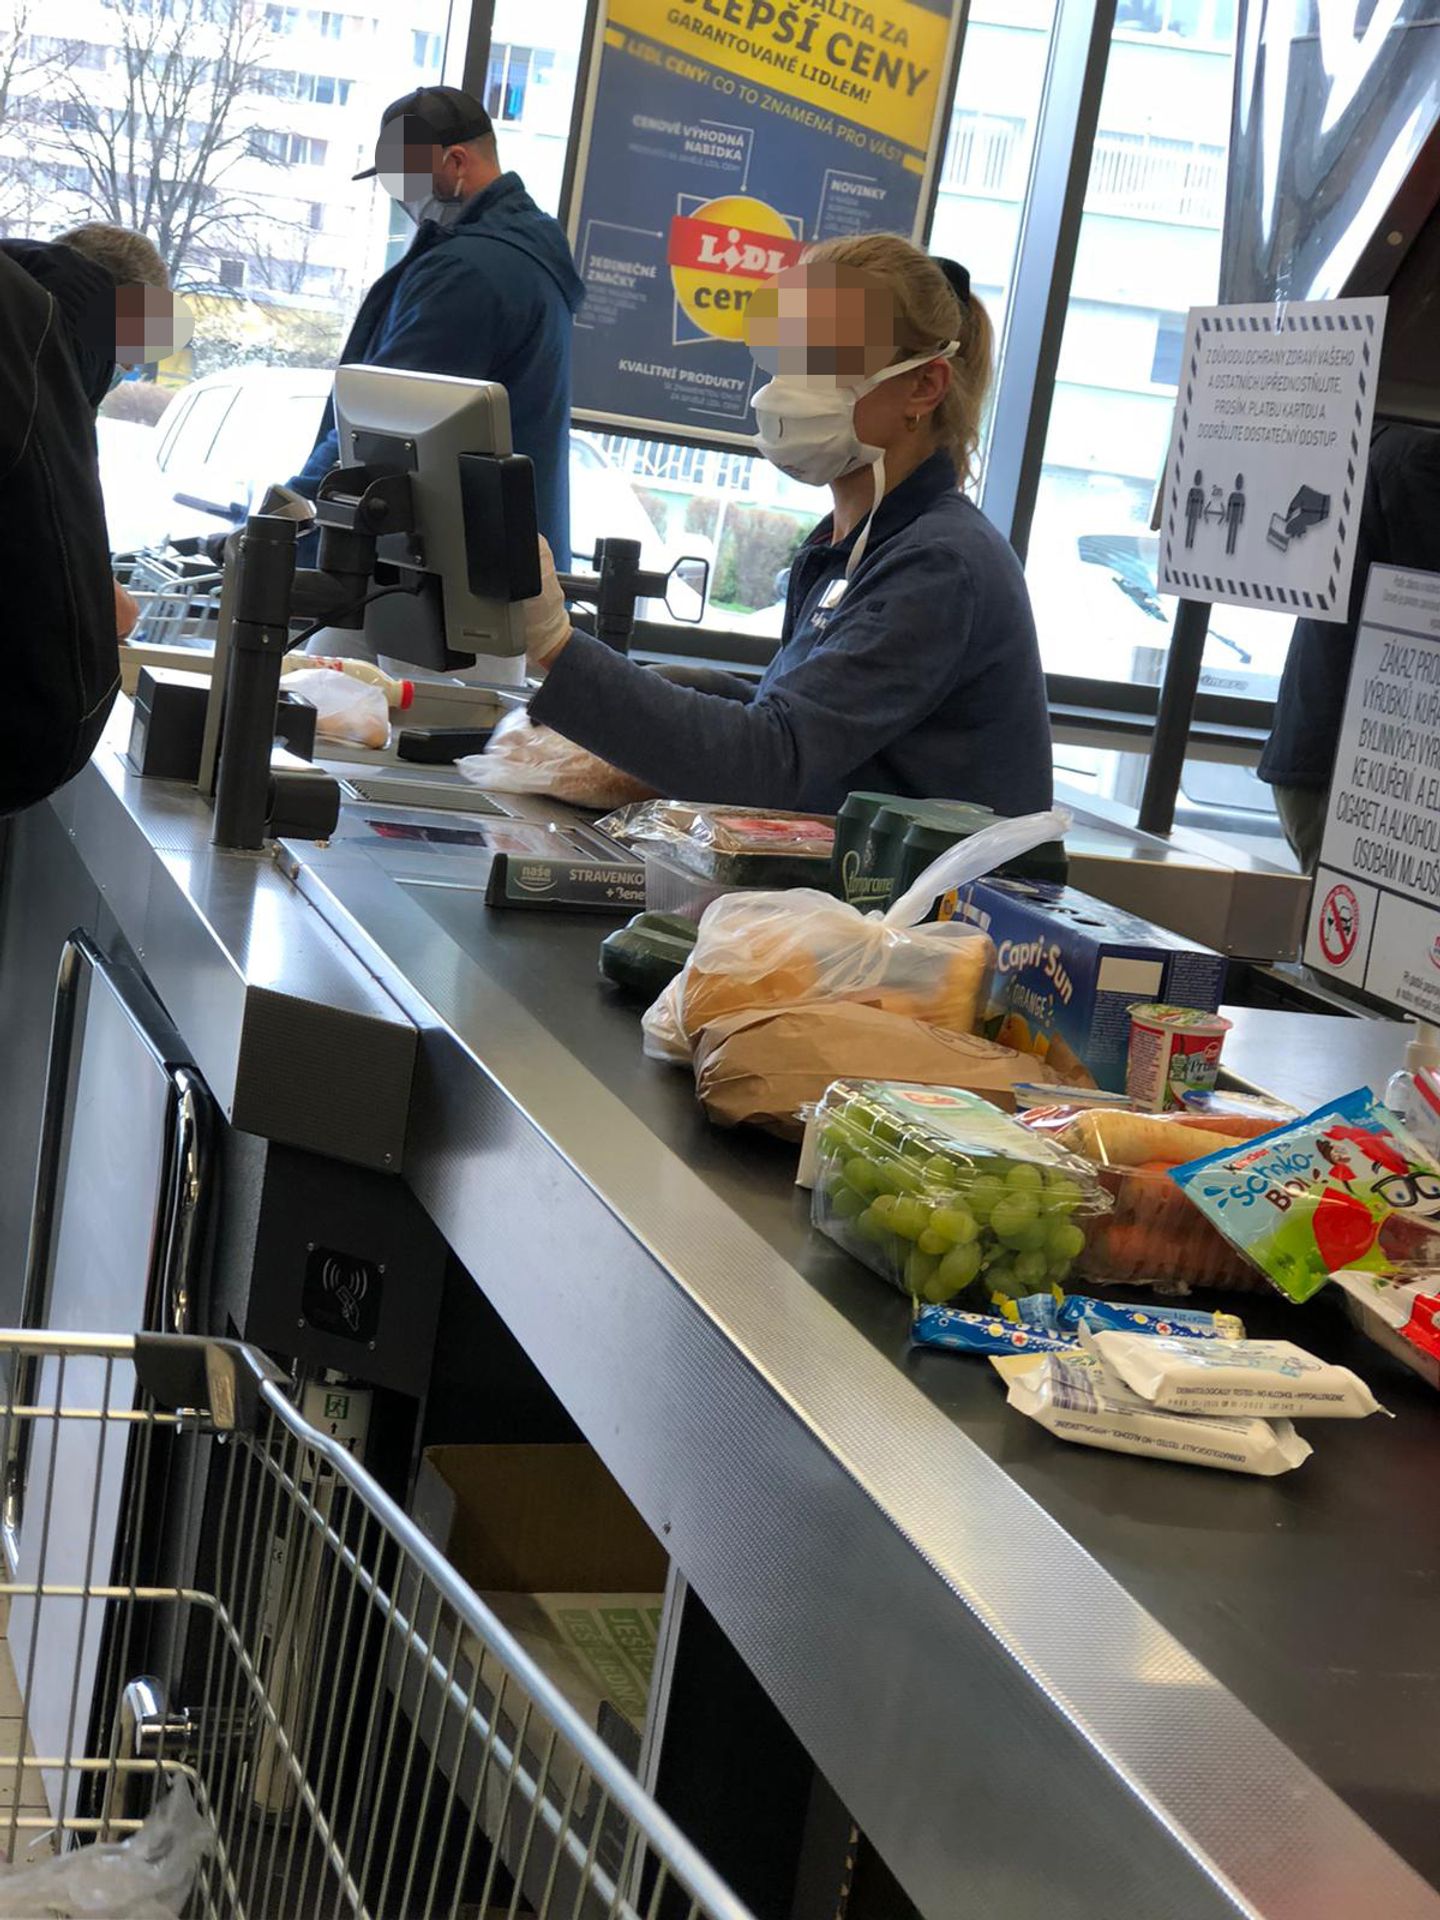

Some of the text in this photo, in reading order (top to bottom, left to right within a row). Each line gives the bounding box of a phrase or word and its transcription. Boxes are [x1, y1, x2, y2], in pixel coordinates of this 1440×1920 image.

[803, 0, 909, 48] ALITA ZA
[667, 9, 872, 104] GARANTOVANÉ LIDLEM!
[682, 0, 930, 97] LEPŠÍ CENY
[711, 76, 735, 95] CO
[739, 85, 759, 105] TO
[760, 94, 833, 134] ZNAMENÁ
[836, 125, 866, 148] PRO
[683, 124, 744, 147] VÝHODNÁ
[684, 140, 742, 161] NABÍDKA
[831, 180, 887, 200] NOVINKY
[694, 286, 753, 311] cen
[618, 359, 677, 379] KVALITNÍ
[679, 369, 745, 391] PRODUKTY
[1299, 428, 1338, 447] ODSTUP
[1379, 639, 1417, 678] ZÁKAZ
[1358, 718, 1419, 761] BYLINNÝCH
[1351, 756, 1368, 788] KE
[1415, 776, 1426, 806] A
[1336, 790, 1380, 832] CIGARET
[1378, 806, 1388, 836] A
[522, 864, 551, 877] naše
[1352, 836, 1400, 880] OSOBÁM
[998, 935, 1073, 1004] Capri-Sun
